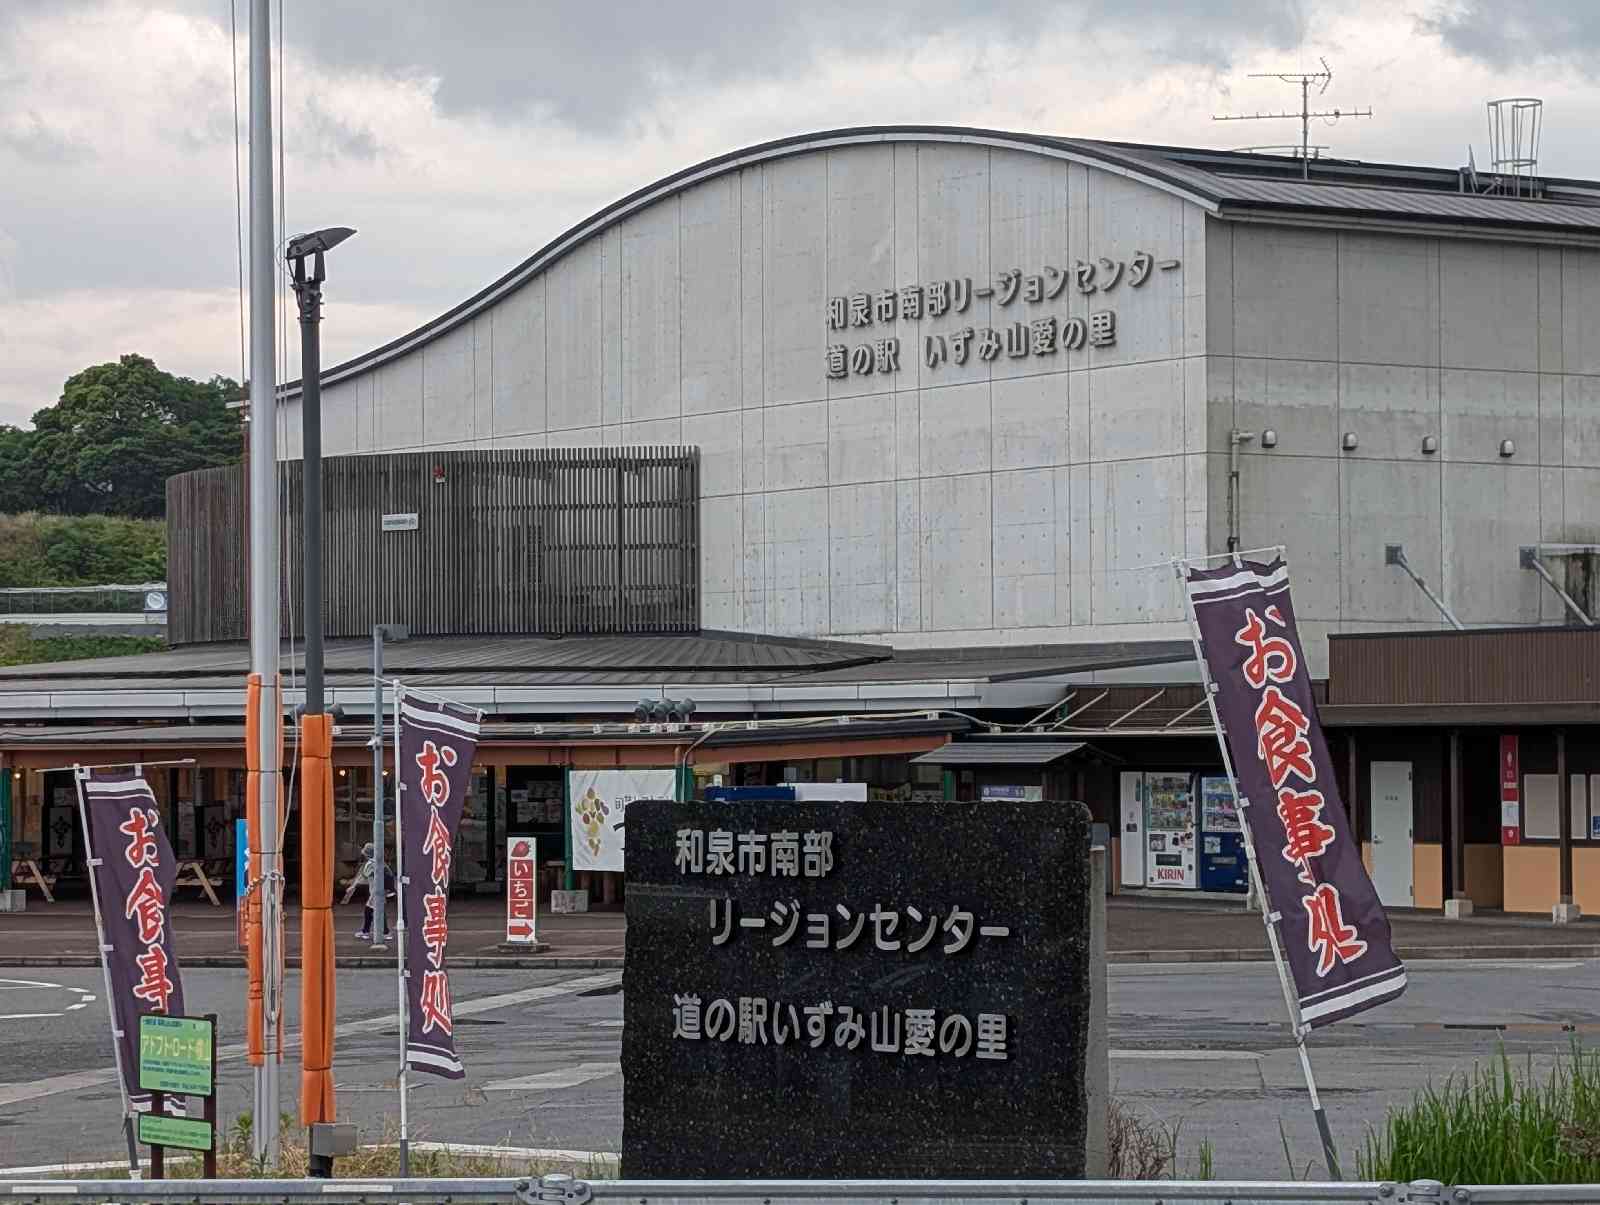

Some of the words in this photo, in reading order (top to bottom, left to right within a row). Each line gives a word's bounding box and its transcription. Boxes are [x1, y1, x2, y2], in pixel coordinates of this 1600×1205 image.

[825, 251, 1181, 330] 和泉市南部リージョンセンター
[825, 337, 900, 379] 道の駅
[923, 310, 1117, 368] いずみ山愛の里
[1234, 604, 1367, 978] お食事処
[674, 828, 835, 878] 和泉市南部
[1157, 868, 1185, 881] KIRIN
[119, 807, 173, 1014] お食事
[513, 861, 529, 918] いちご
[709, 898, 1010, 955] リージョンセンター
[672, 992, 1009, 1061] 道の駅いずみ山愛の里
